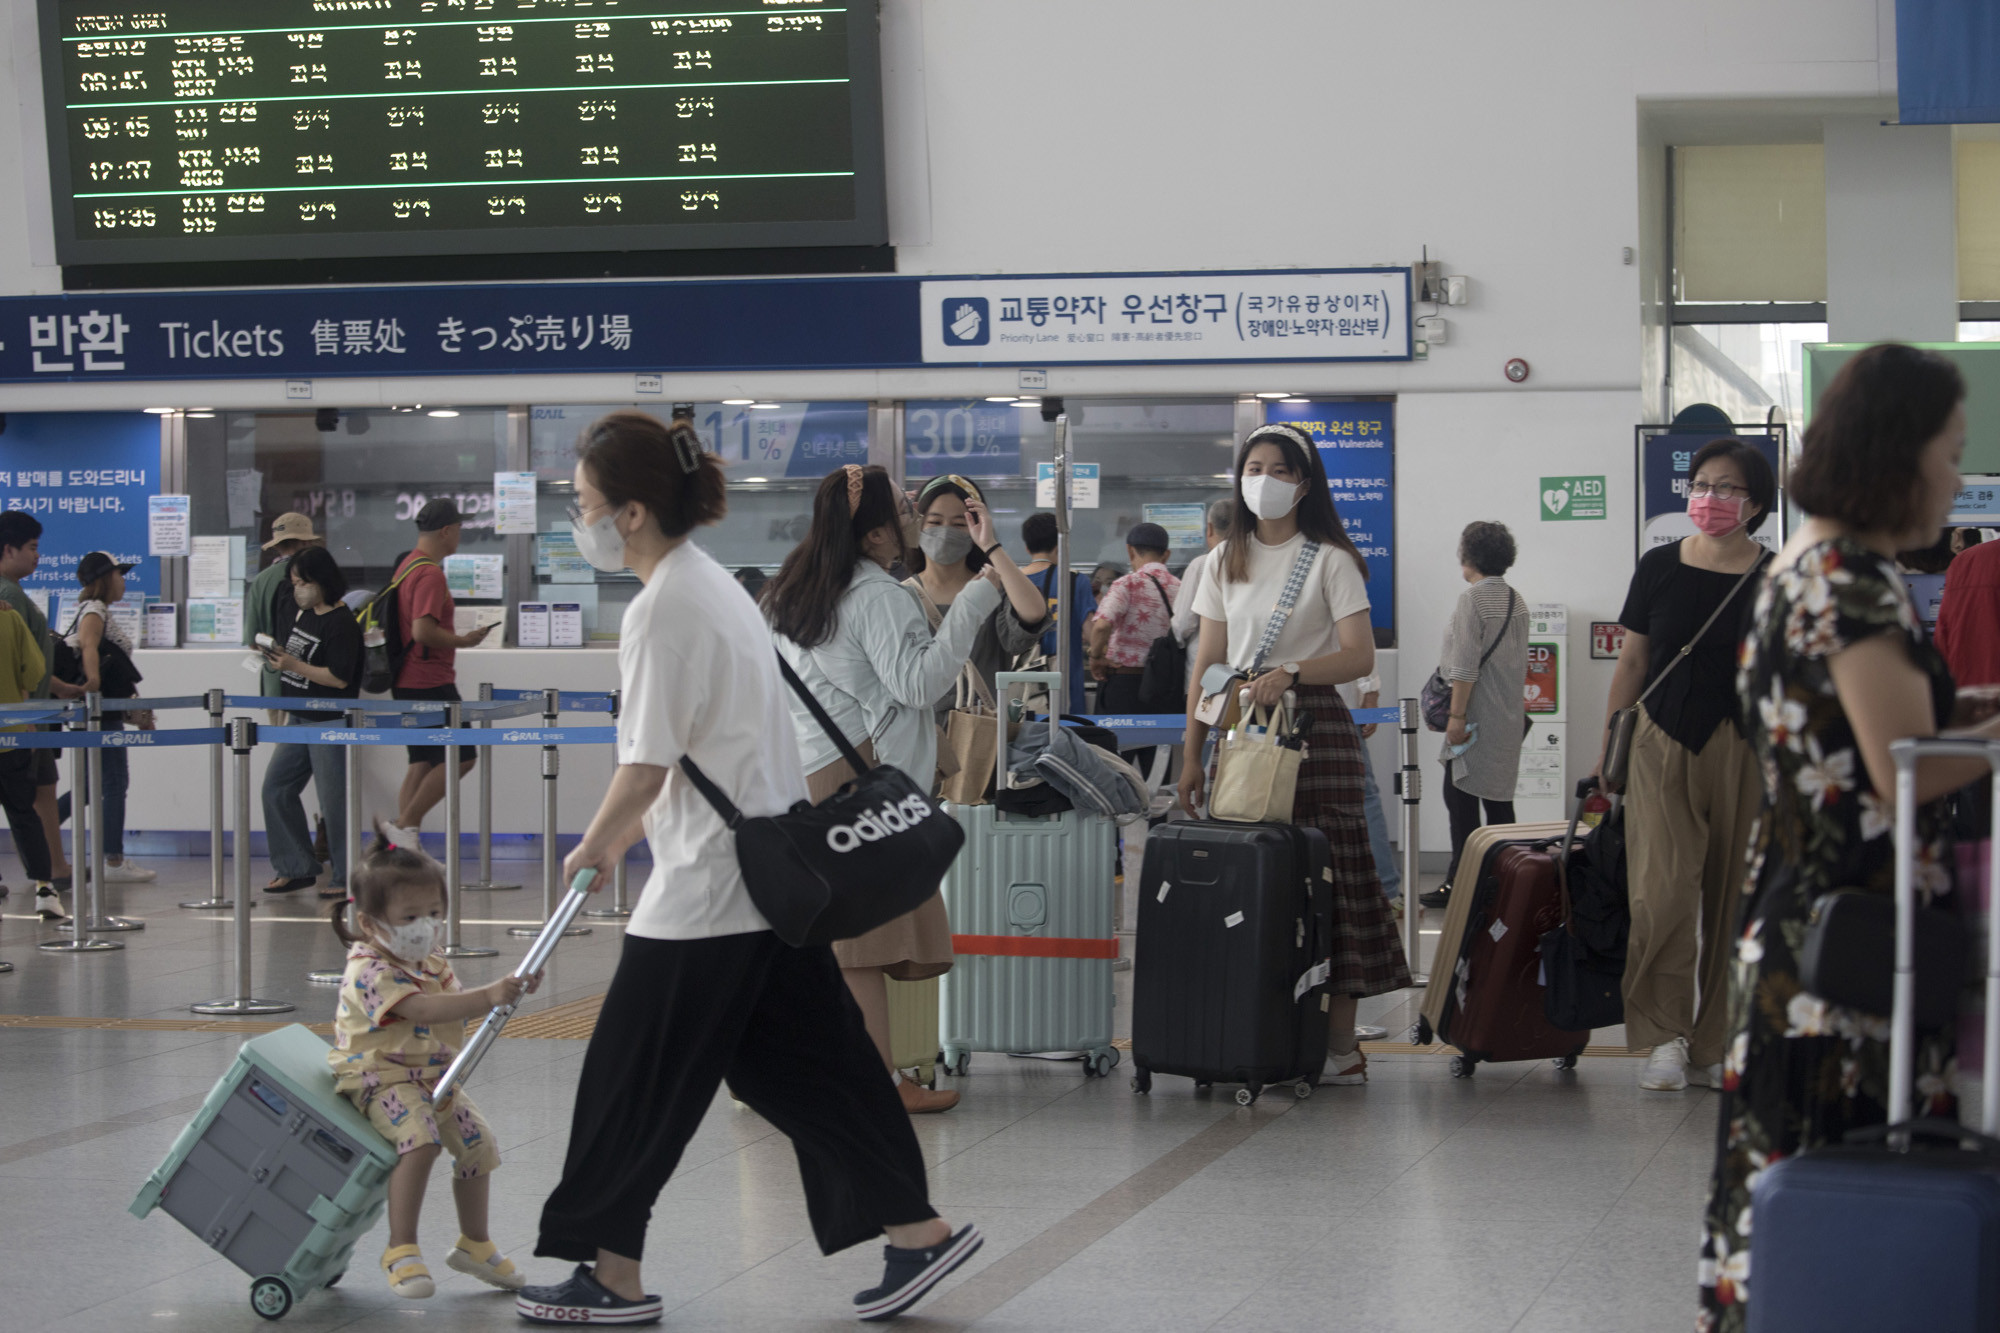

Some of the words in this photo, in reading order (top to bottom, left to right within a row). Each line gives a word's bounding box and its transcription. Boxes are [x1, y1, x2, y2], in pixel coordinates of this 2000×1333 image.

[999, 295, 1107, 328] 교통약자
[1121, 292, 1228, 325] 우선창구
[1247, 293, 1380, 314] 국가유공상이자
[29, 310, 130, 373] 반환
[160, 319, 285, 359] Tickets
[310, 317, 407, 356] 售票处
[436, 313, 634, 355] きっぷ売り場
[1000, 333, 1035, 345] Priority
[1036, 333, 1060, 343] Lane
[909, 407, 974, 460] 30
[1329, 420, 1354, 436] 우선
[1357, 420, 1382, 436] 창구
[1315, 440, 1338, 449] ation
[1338, 439, 1384, 450] Vulnerable
[16, 470, 63, 488] 발매를
[68, 469, 146, 487] 도와드리니
[1573, 480, 1602, 497] AED
[8, 497, 53, 514] 주시기
[58, 496, 125, 514] 바랍니다.
[60, 554, 78, 565] the
[1528, 611, 1565, 620] 심장충격기
[1528, 646, 1550, 662] ED
[1098, 717, 1135, 728] KORAIL
[102, 732, 154, 746] KORAIL
[320, 730, 359, 742] KORAIL
[502, 730, 542, 743] KORAIL
[826, 793, 932, 853] adidas
[533, 1304, 591, 1321] crocs
